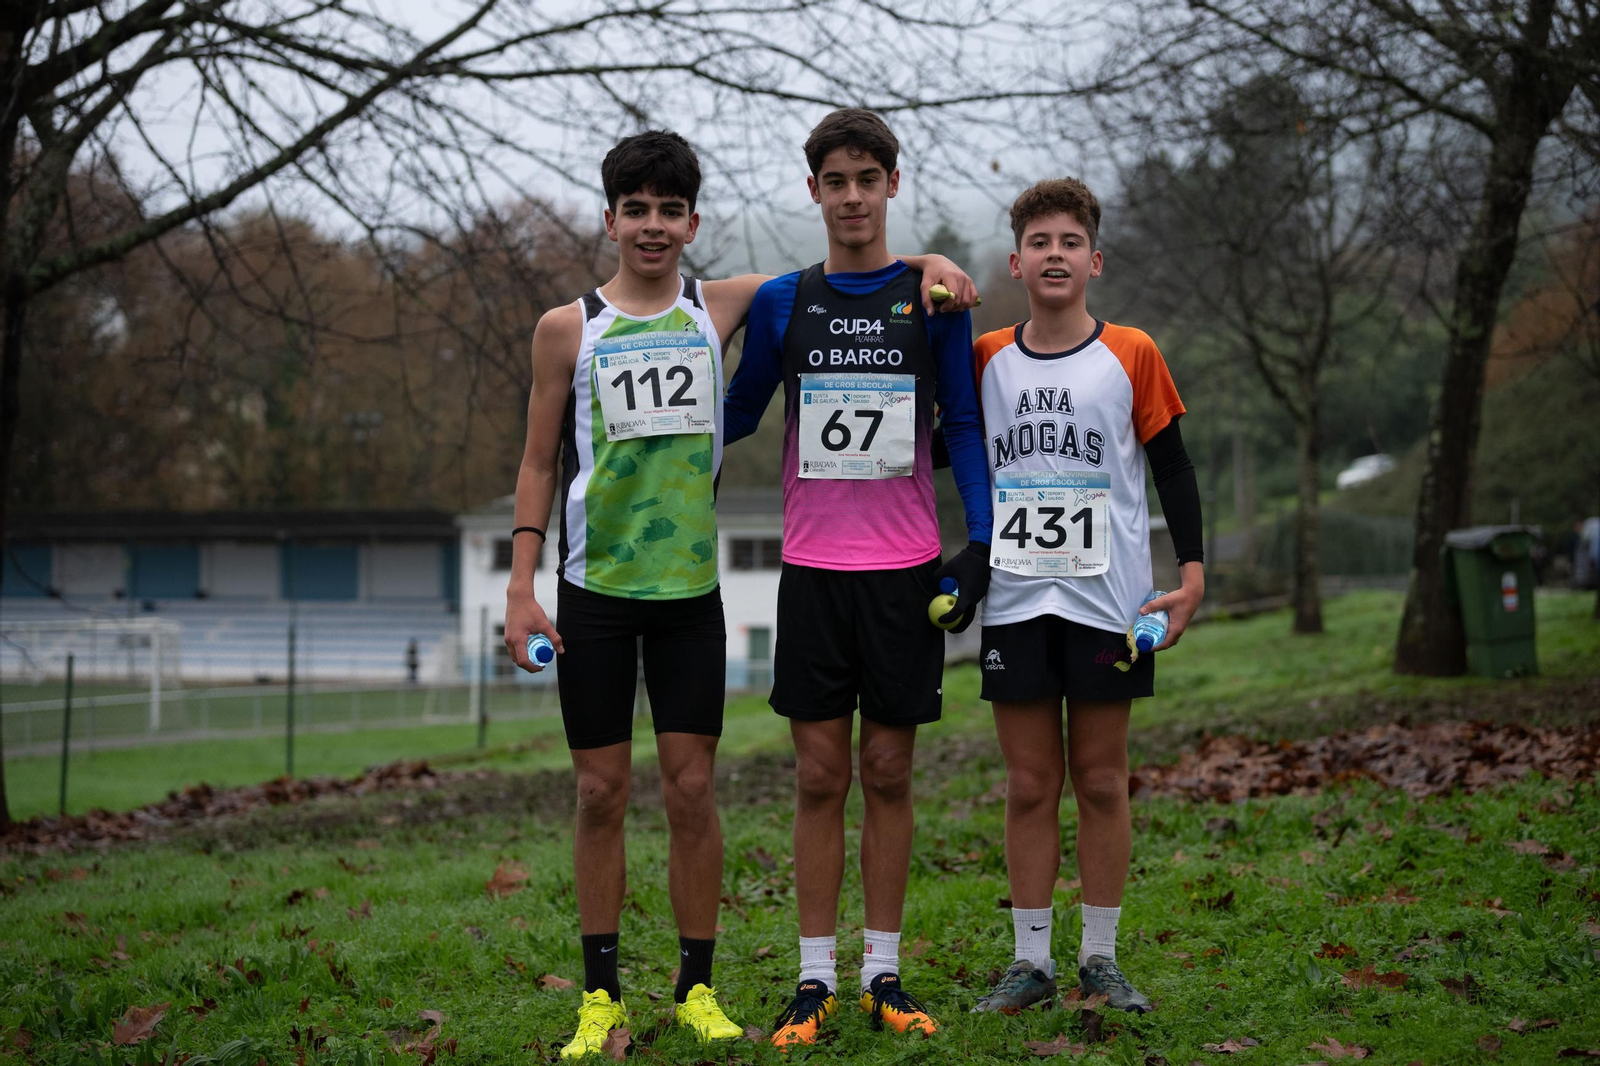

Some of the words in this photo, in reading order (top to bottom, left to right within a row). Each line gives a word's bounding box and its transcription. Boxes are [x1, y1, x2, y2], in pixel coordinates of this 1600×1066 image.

[830, 319, 884, 334] CUPA
[633, 341, 655, 349] CROS
[809, 350, 823, 366] O
[830, 349, 903, 366] BARCO
[611, 365, 697, 411] 112
[1015, 387, 1074, 418] ANA
[821, 410, 884, 451] 67
[992, 420, 1105, 472] MOGAS
[999, 507, 1092, 549] 431
